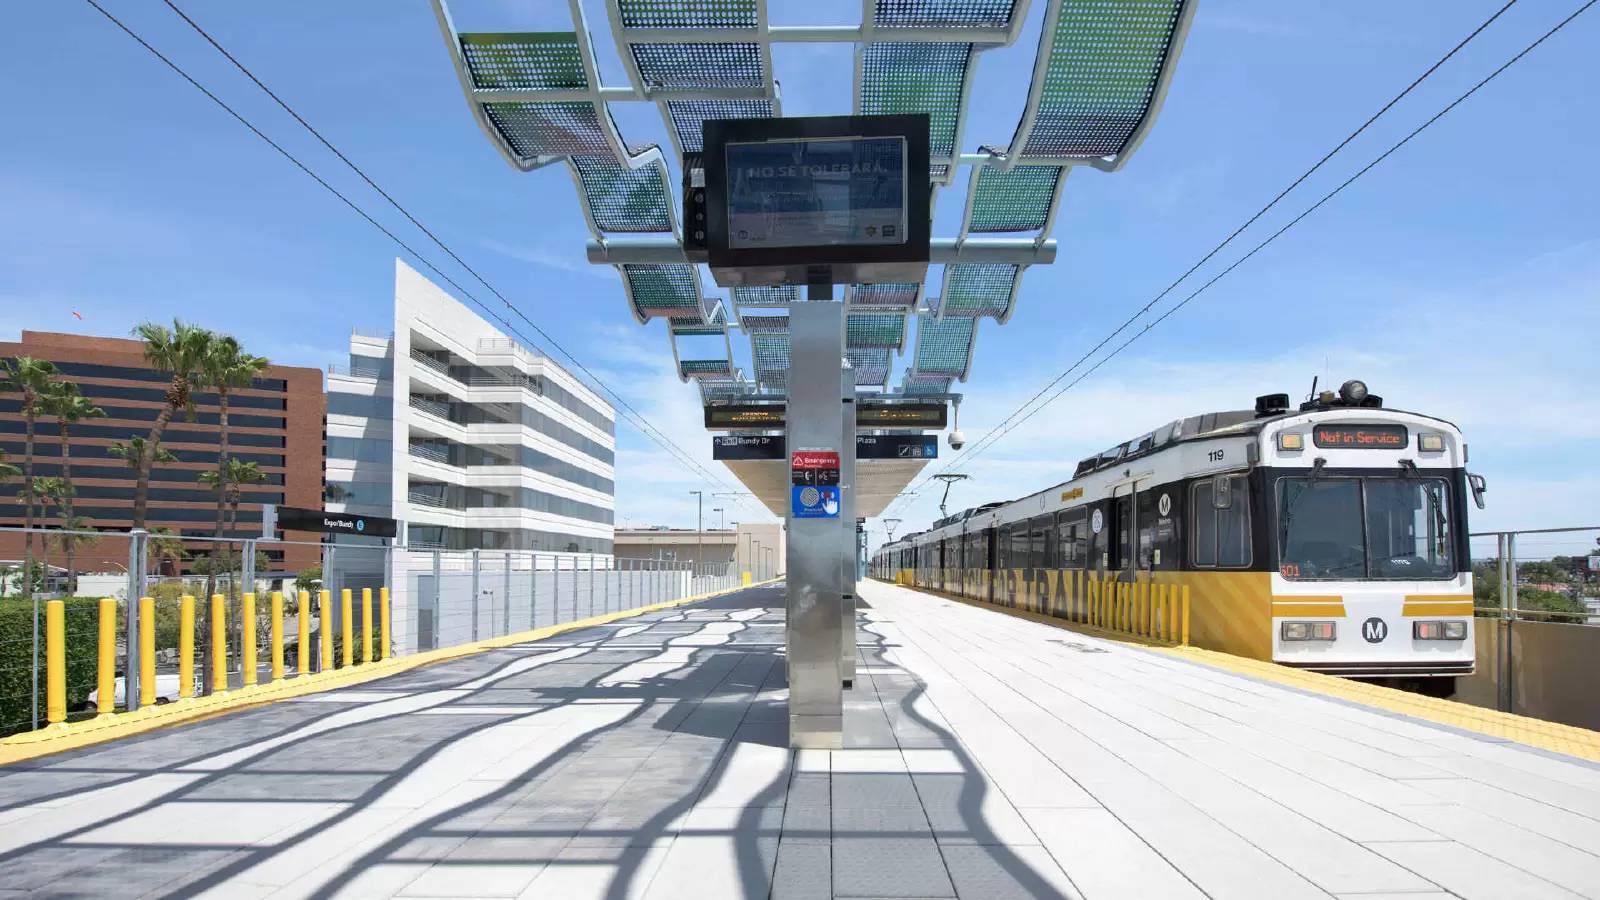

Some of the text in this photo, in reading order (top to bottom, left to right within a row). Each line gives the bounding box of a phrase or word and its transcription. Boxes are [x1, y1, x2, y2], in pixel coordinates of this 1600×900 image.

[749, 167, 773, 178] NO
[778, 166, 796, 177] SE
[738, 437, 760, 446] Bundy
[761, 437, 771, 445] Dr
[857, 436, 877, 445] Plaza
[1320, 431, 1401, 443] Not in Service
[1207, 449, 1224, 462] 119
[804, 457, 836, 466] Emergency
[324, 518, 354, 529] Expo/Bundy
[1366, 622, 1384, 640] M
